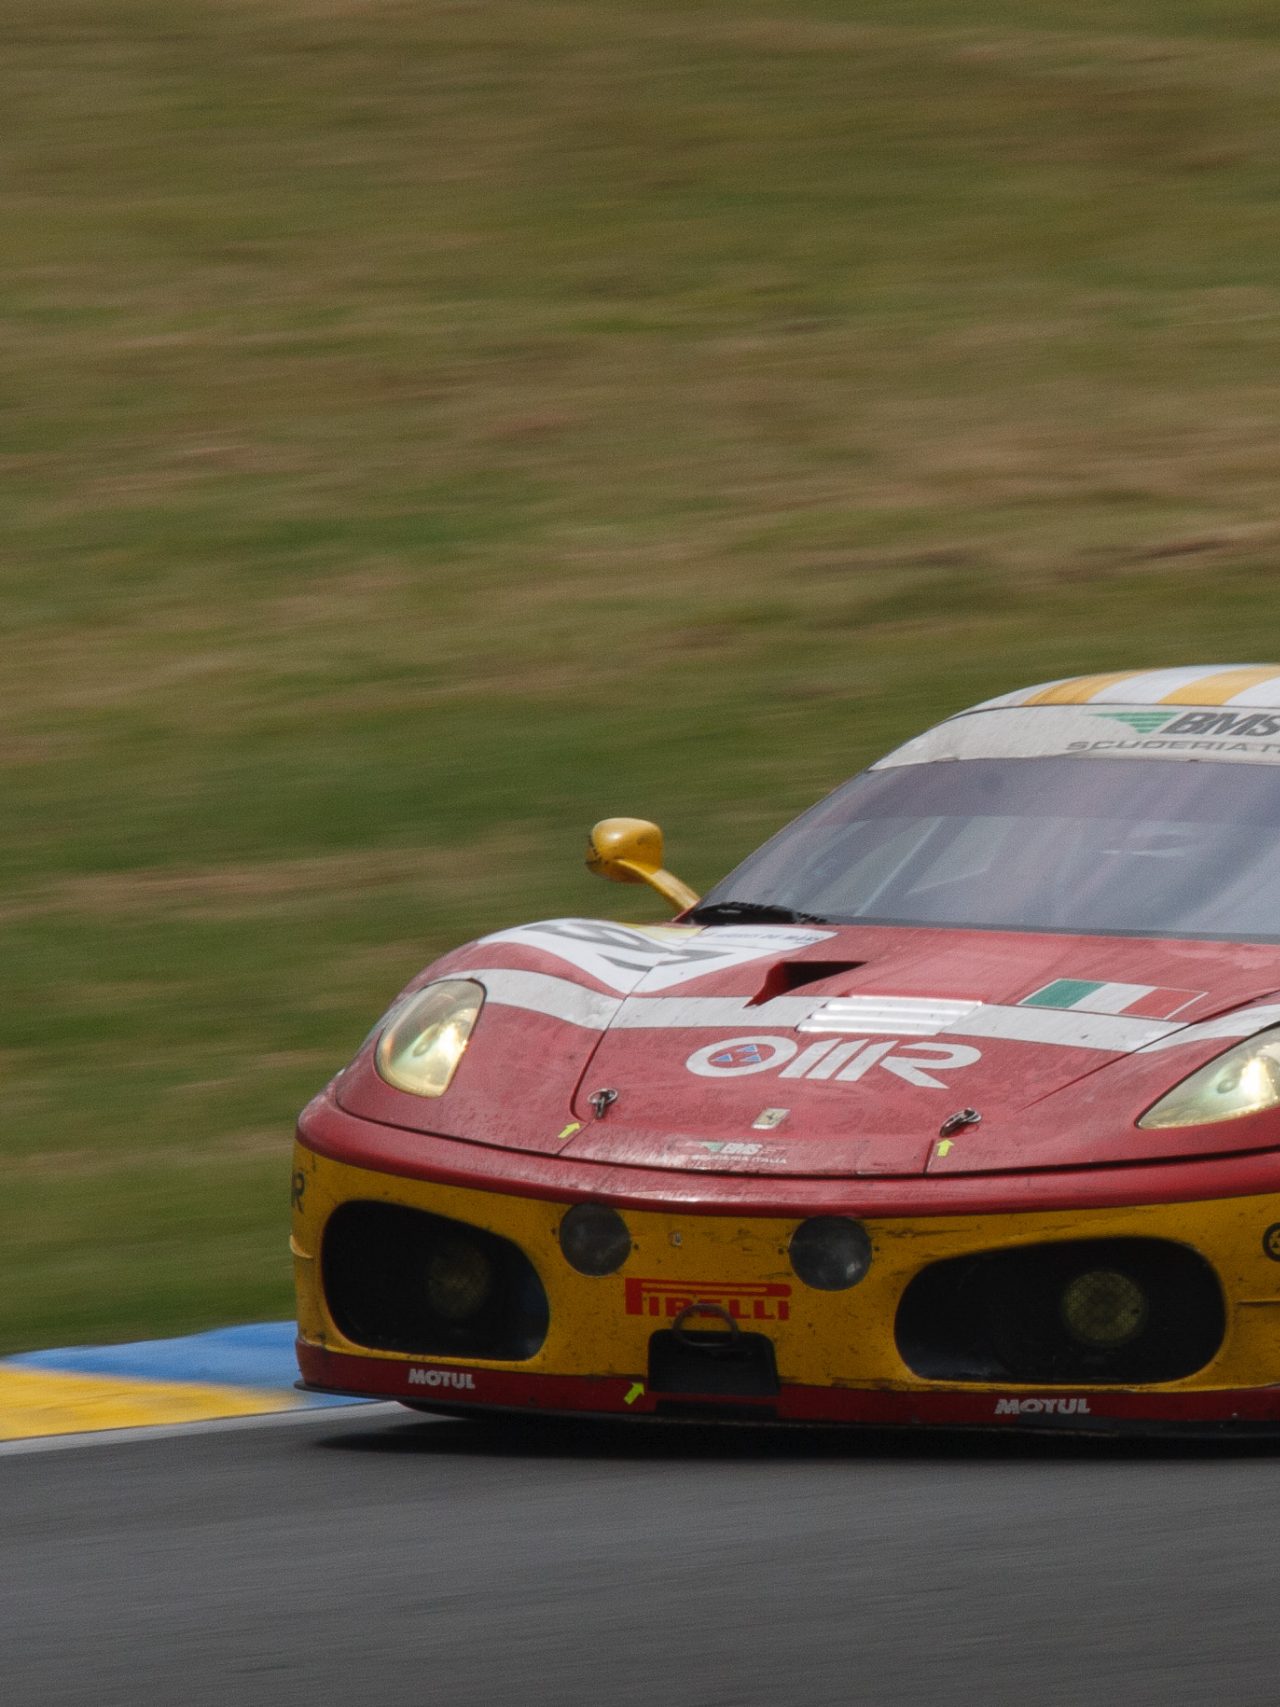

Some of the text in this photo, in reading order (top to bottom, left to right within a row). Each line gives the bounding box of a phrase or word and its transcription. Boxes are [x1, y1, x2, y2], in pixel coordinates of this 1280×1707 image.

[1066, 739, 1249, 753] SCUDERIA
[625, 1278, 791, 1320] PIRELLI
[408, 1368, 475, 1390] MOTUL
[994, 1397, 1091, 1416] MOTUL
